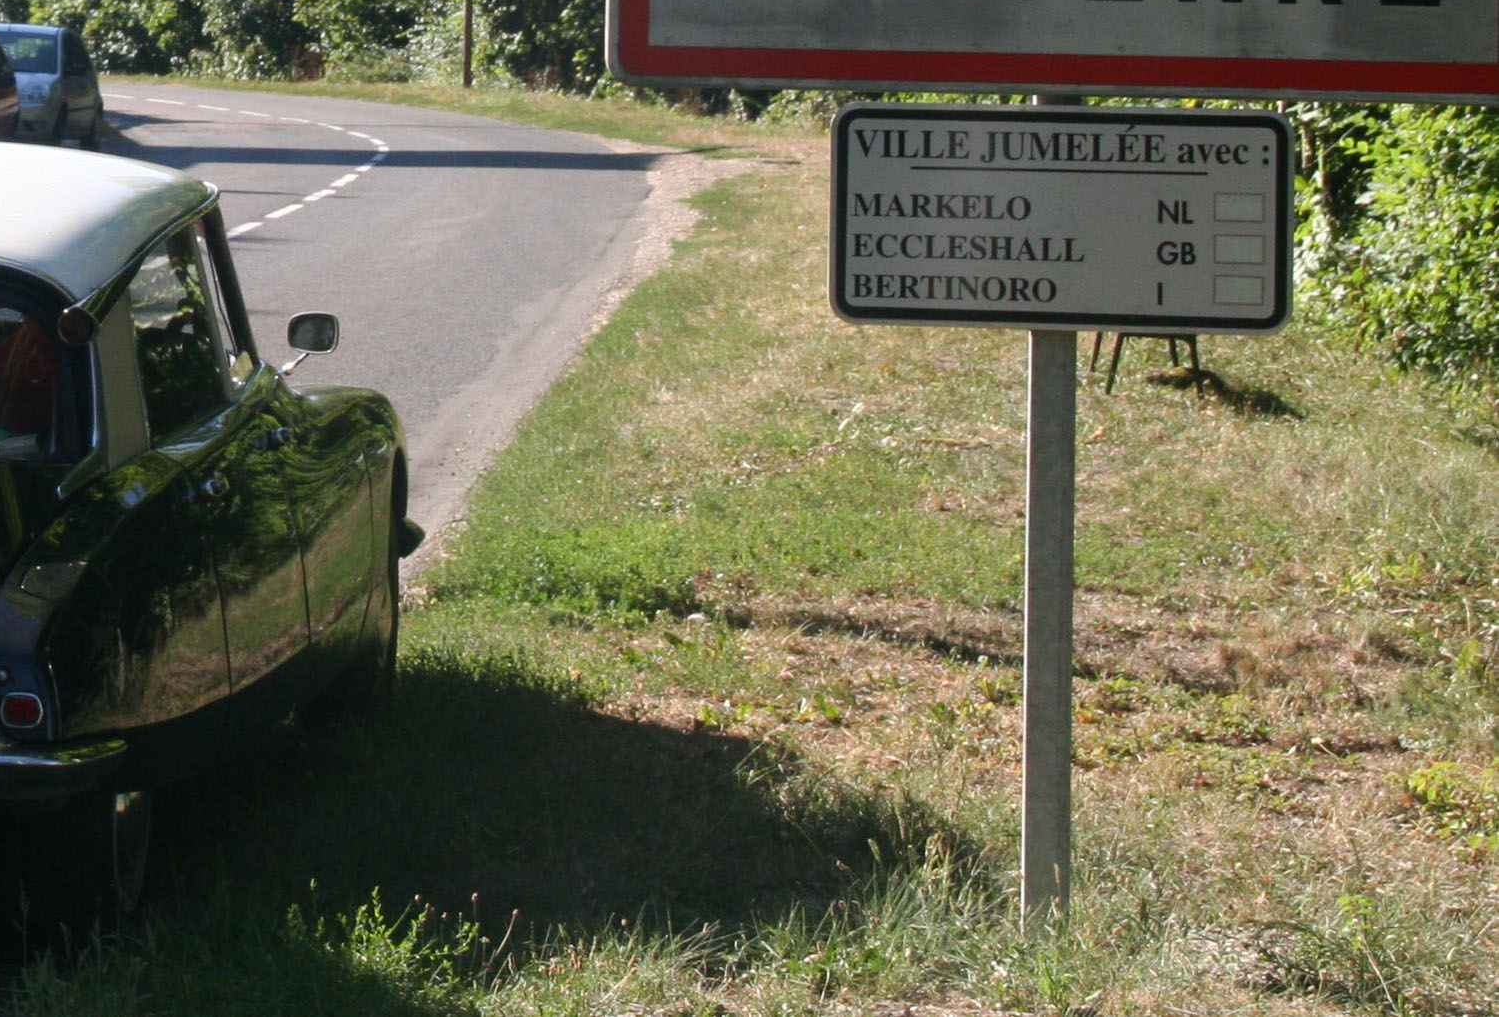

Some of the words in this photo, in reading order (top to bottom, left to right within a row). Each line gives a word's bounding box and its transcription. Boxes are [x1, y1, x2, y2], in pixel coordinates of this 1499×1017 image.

[855, 129, 969, 159] VILLE
[981, 124, 1168, 163] JUMELÉE
[1178, 144, 1248, 165] avec
[853, 193, 1031, 220] MARKELO
[1158, 200, 1193, 224] NL
[852, 234, 1084, 262] ECCLESHALL
[1157, 241, 1196, 265] GB
[852, 274, 1057, 302] BERTINORO
